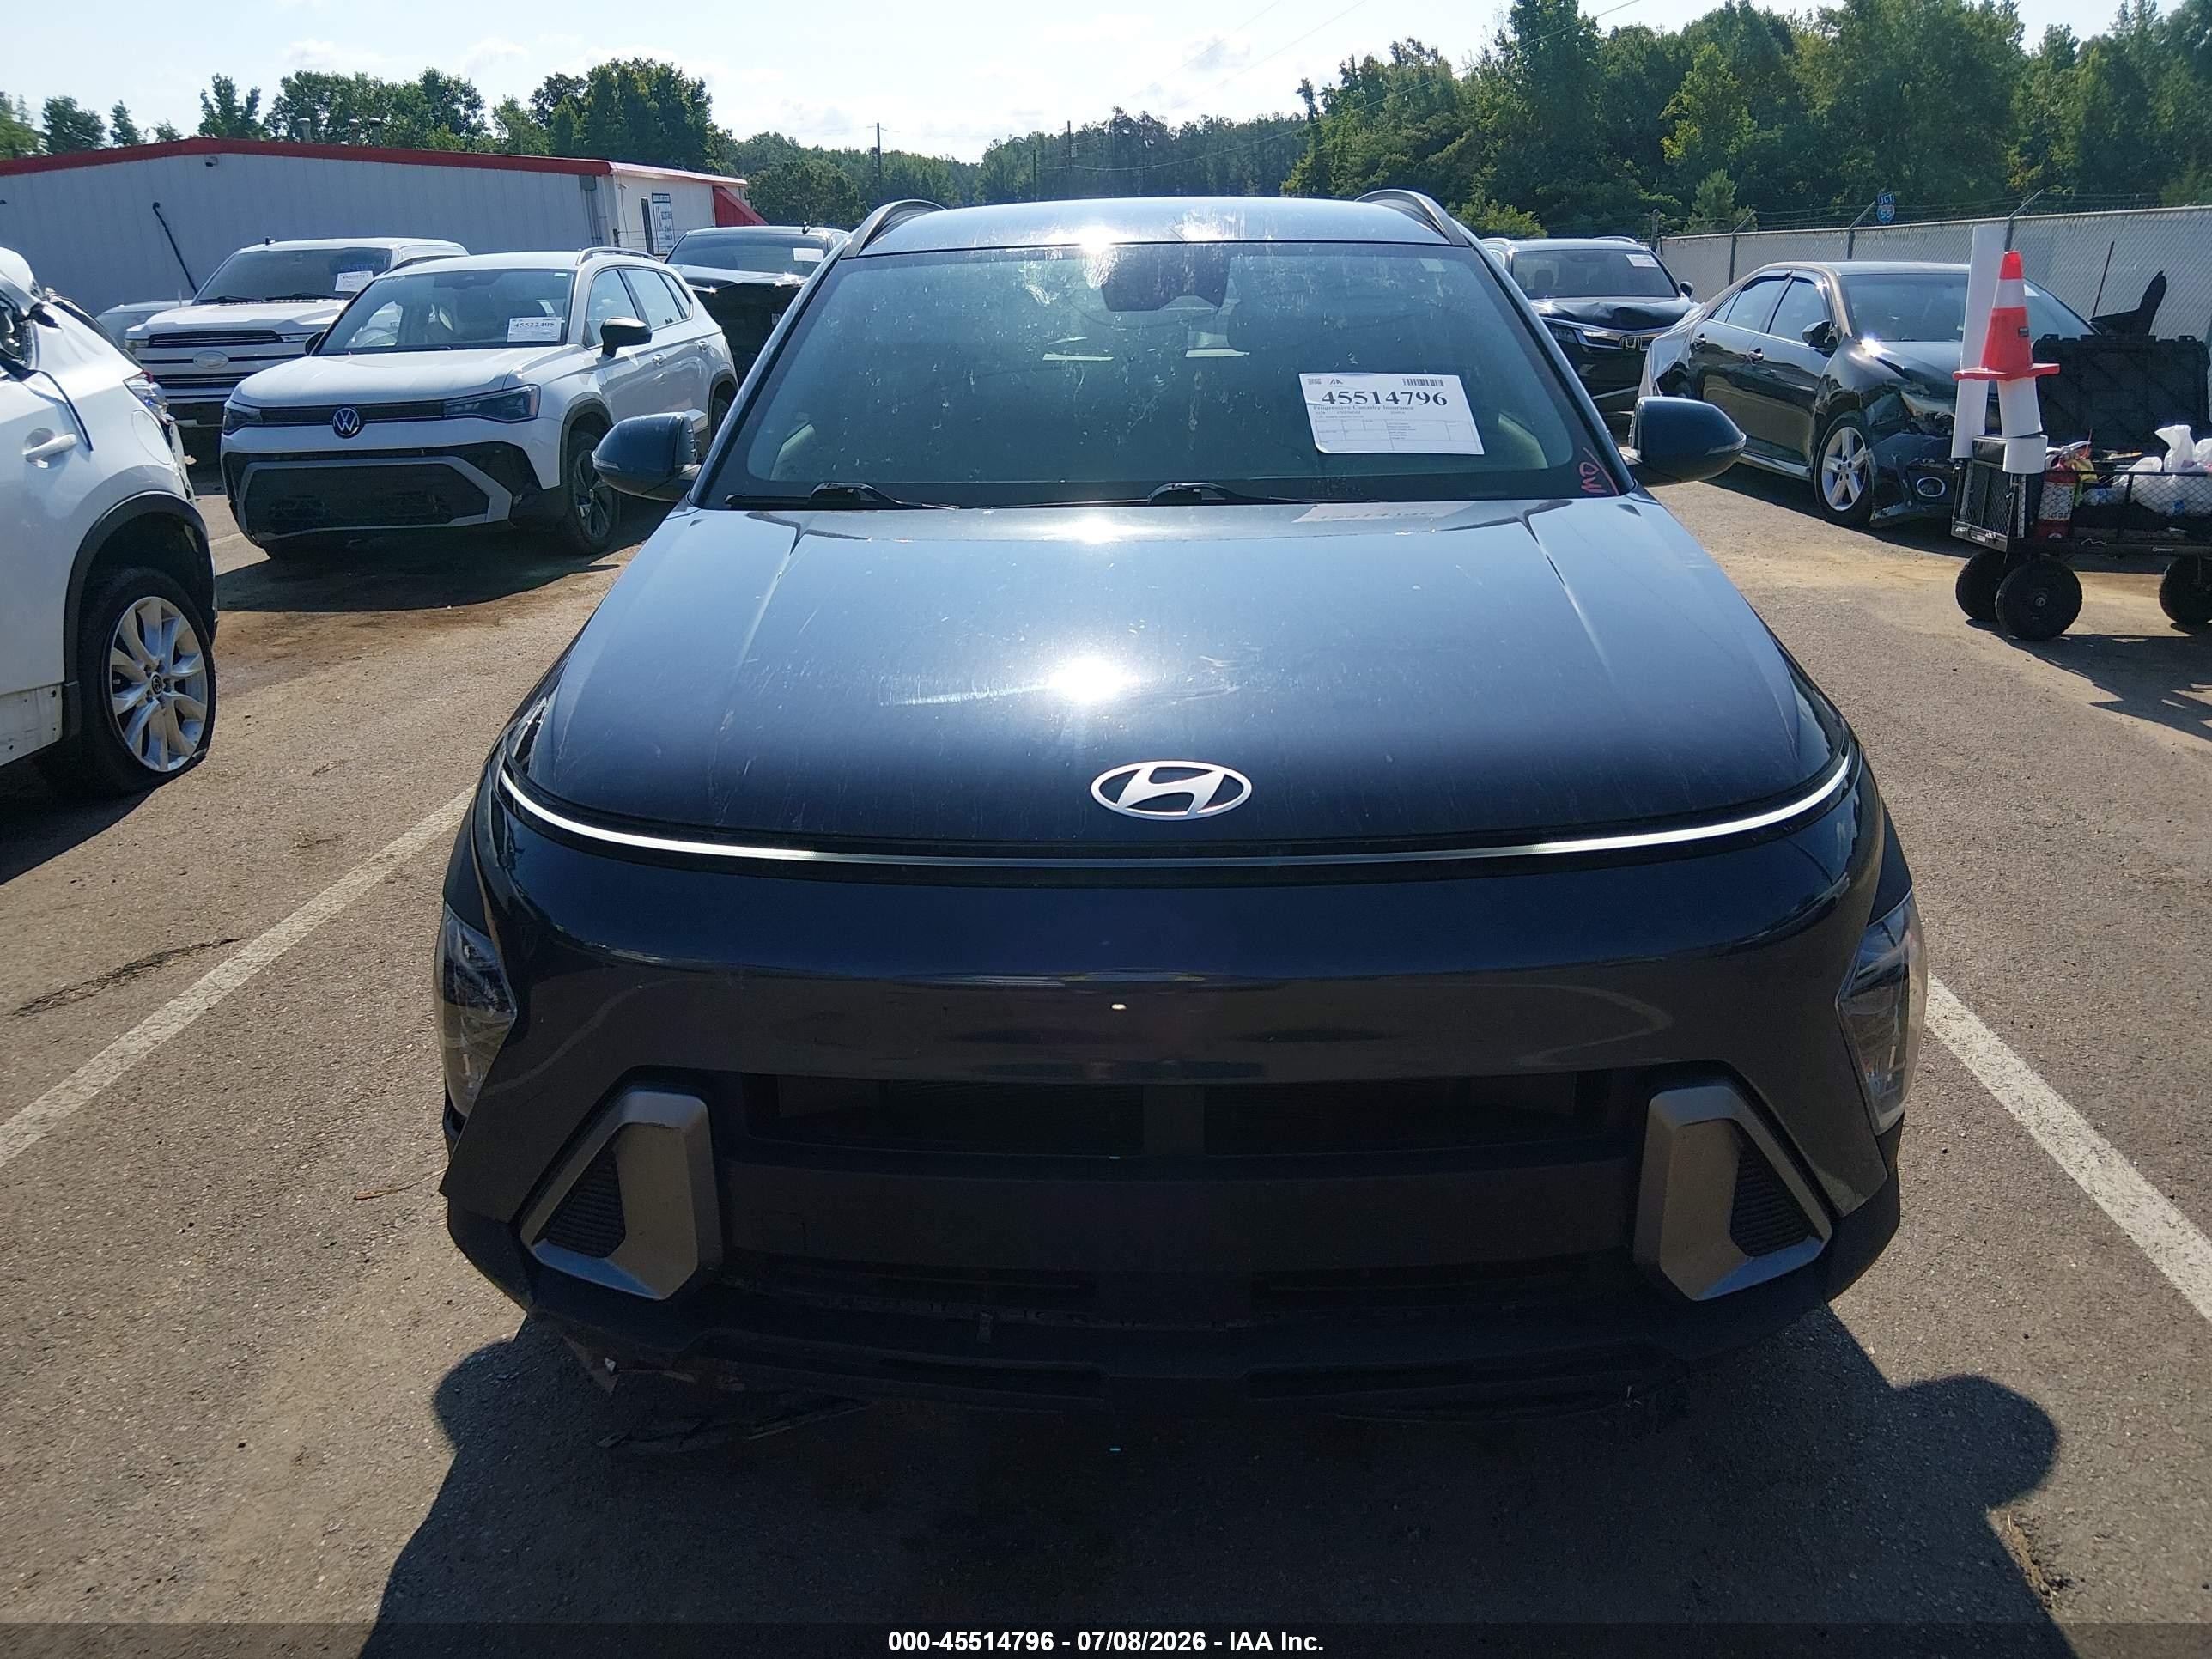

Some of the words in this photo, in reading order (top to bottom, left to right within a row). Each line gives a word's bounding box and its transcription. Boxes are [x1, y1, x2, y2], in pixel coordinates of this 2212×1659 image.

[1880, 193, 1893, 204] JCT
[1881, 210, 1893, 219] 55
[1322, 391, 1448, 406] 45514796
